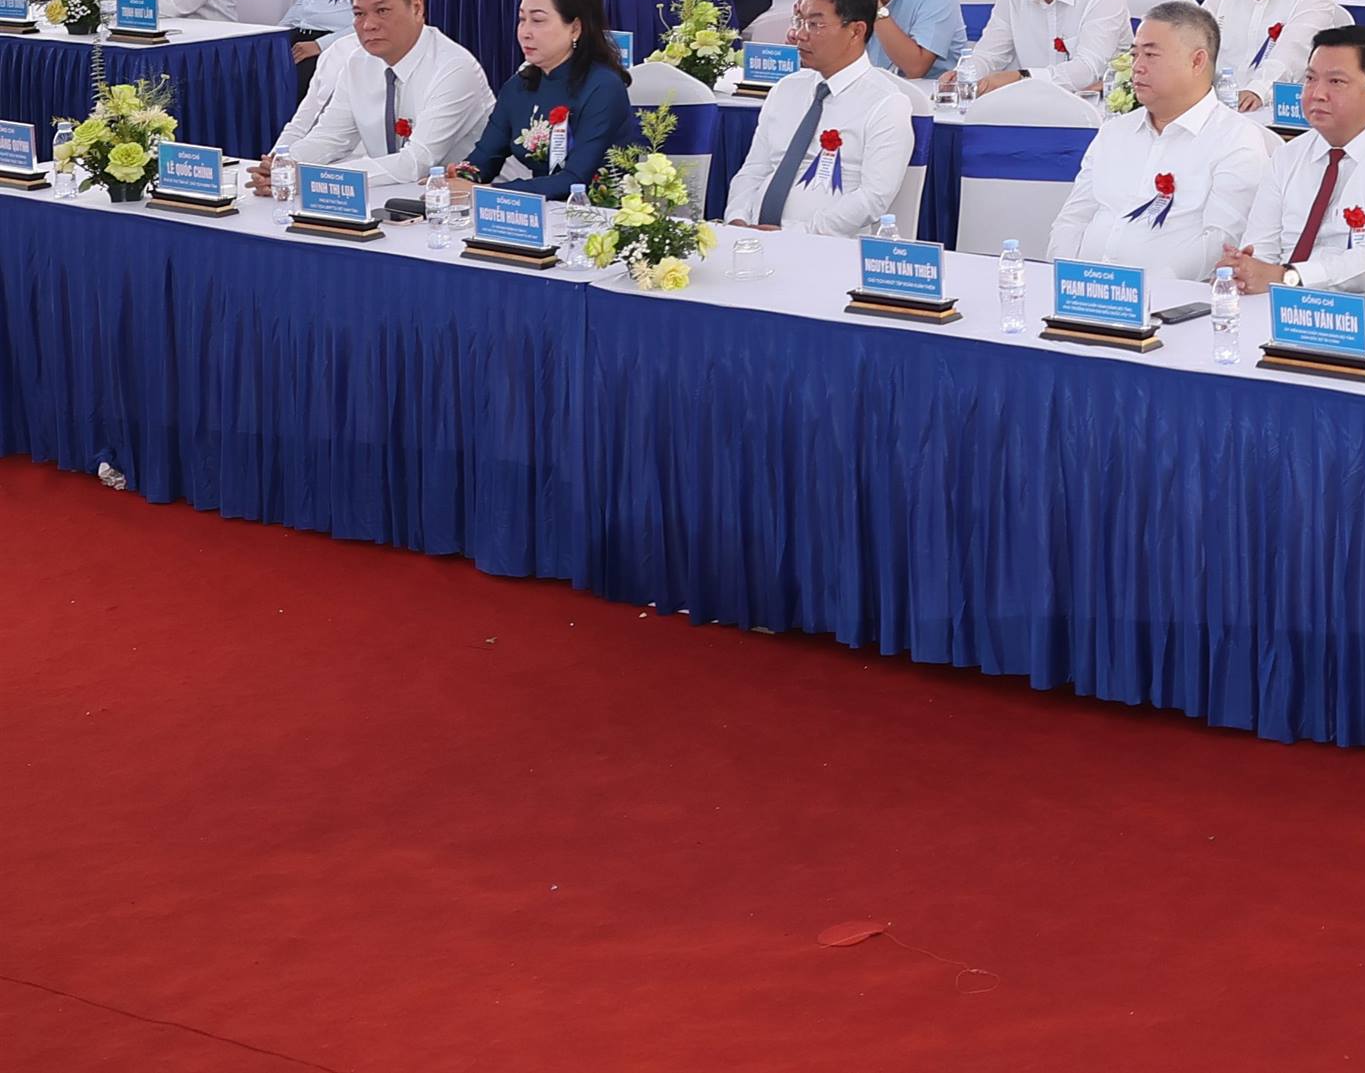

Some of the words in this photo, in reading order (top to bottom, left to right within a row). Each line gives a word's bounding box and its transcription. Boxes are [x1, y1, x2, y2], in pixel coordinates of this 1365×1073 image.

[864, 256, 896, 275] NGUYỄN
[897, 259, 913, 277] VĂN
[1061, 279, 1085, 299] PHẠM
[1086, 280, 1110, 300] HÙNG
[1111, 279, 1138, 304] THẮNG
[1301, 294, 1321, 305] ĐỒNG
[1322, 296, 1334, 307] CHÍ
[1280, 305, 1313, 328] HOÀNG
[1314, 308, 1334, 330] VĂN
